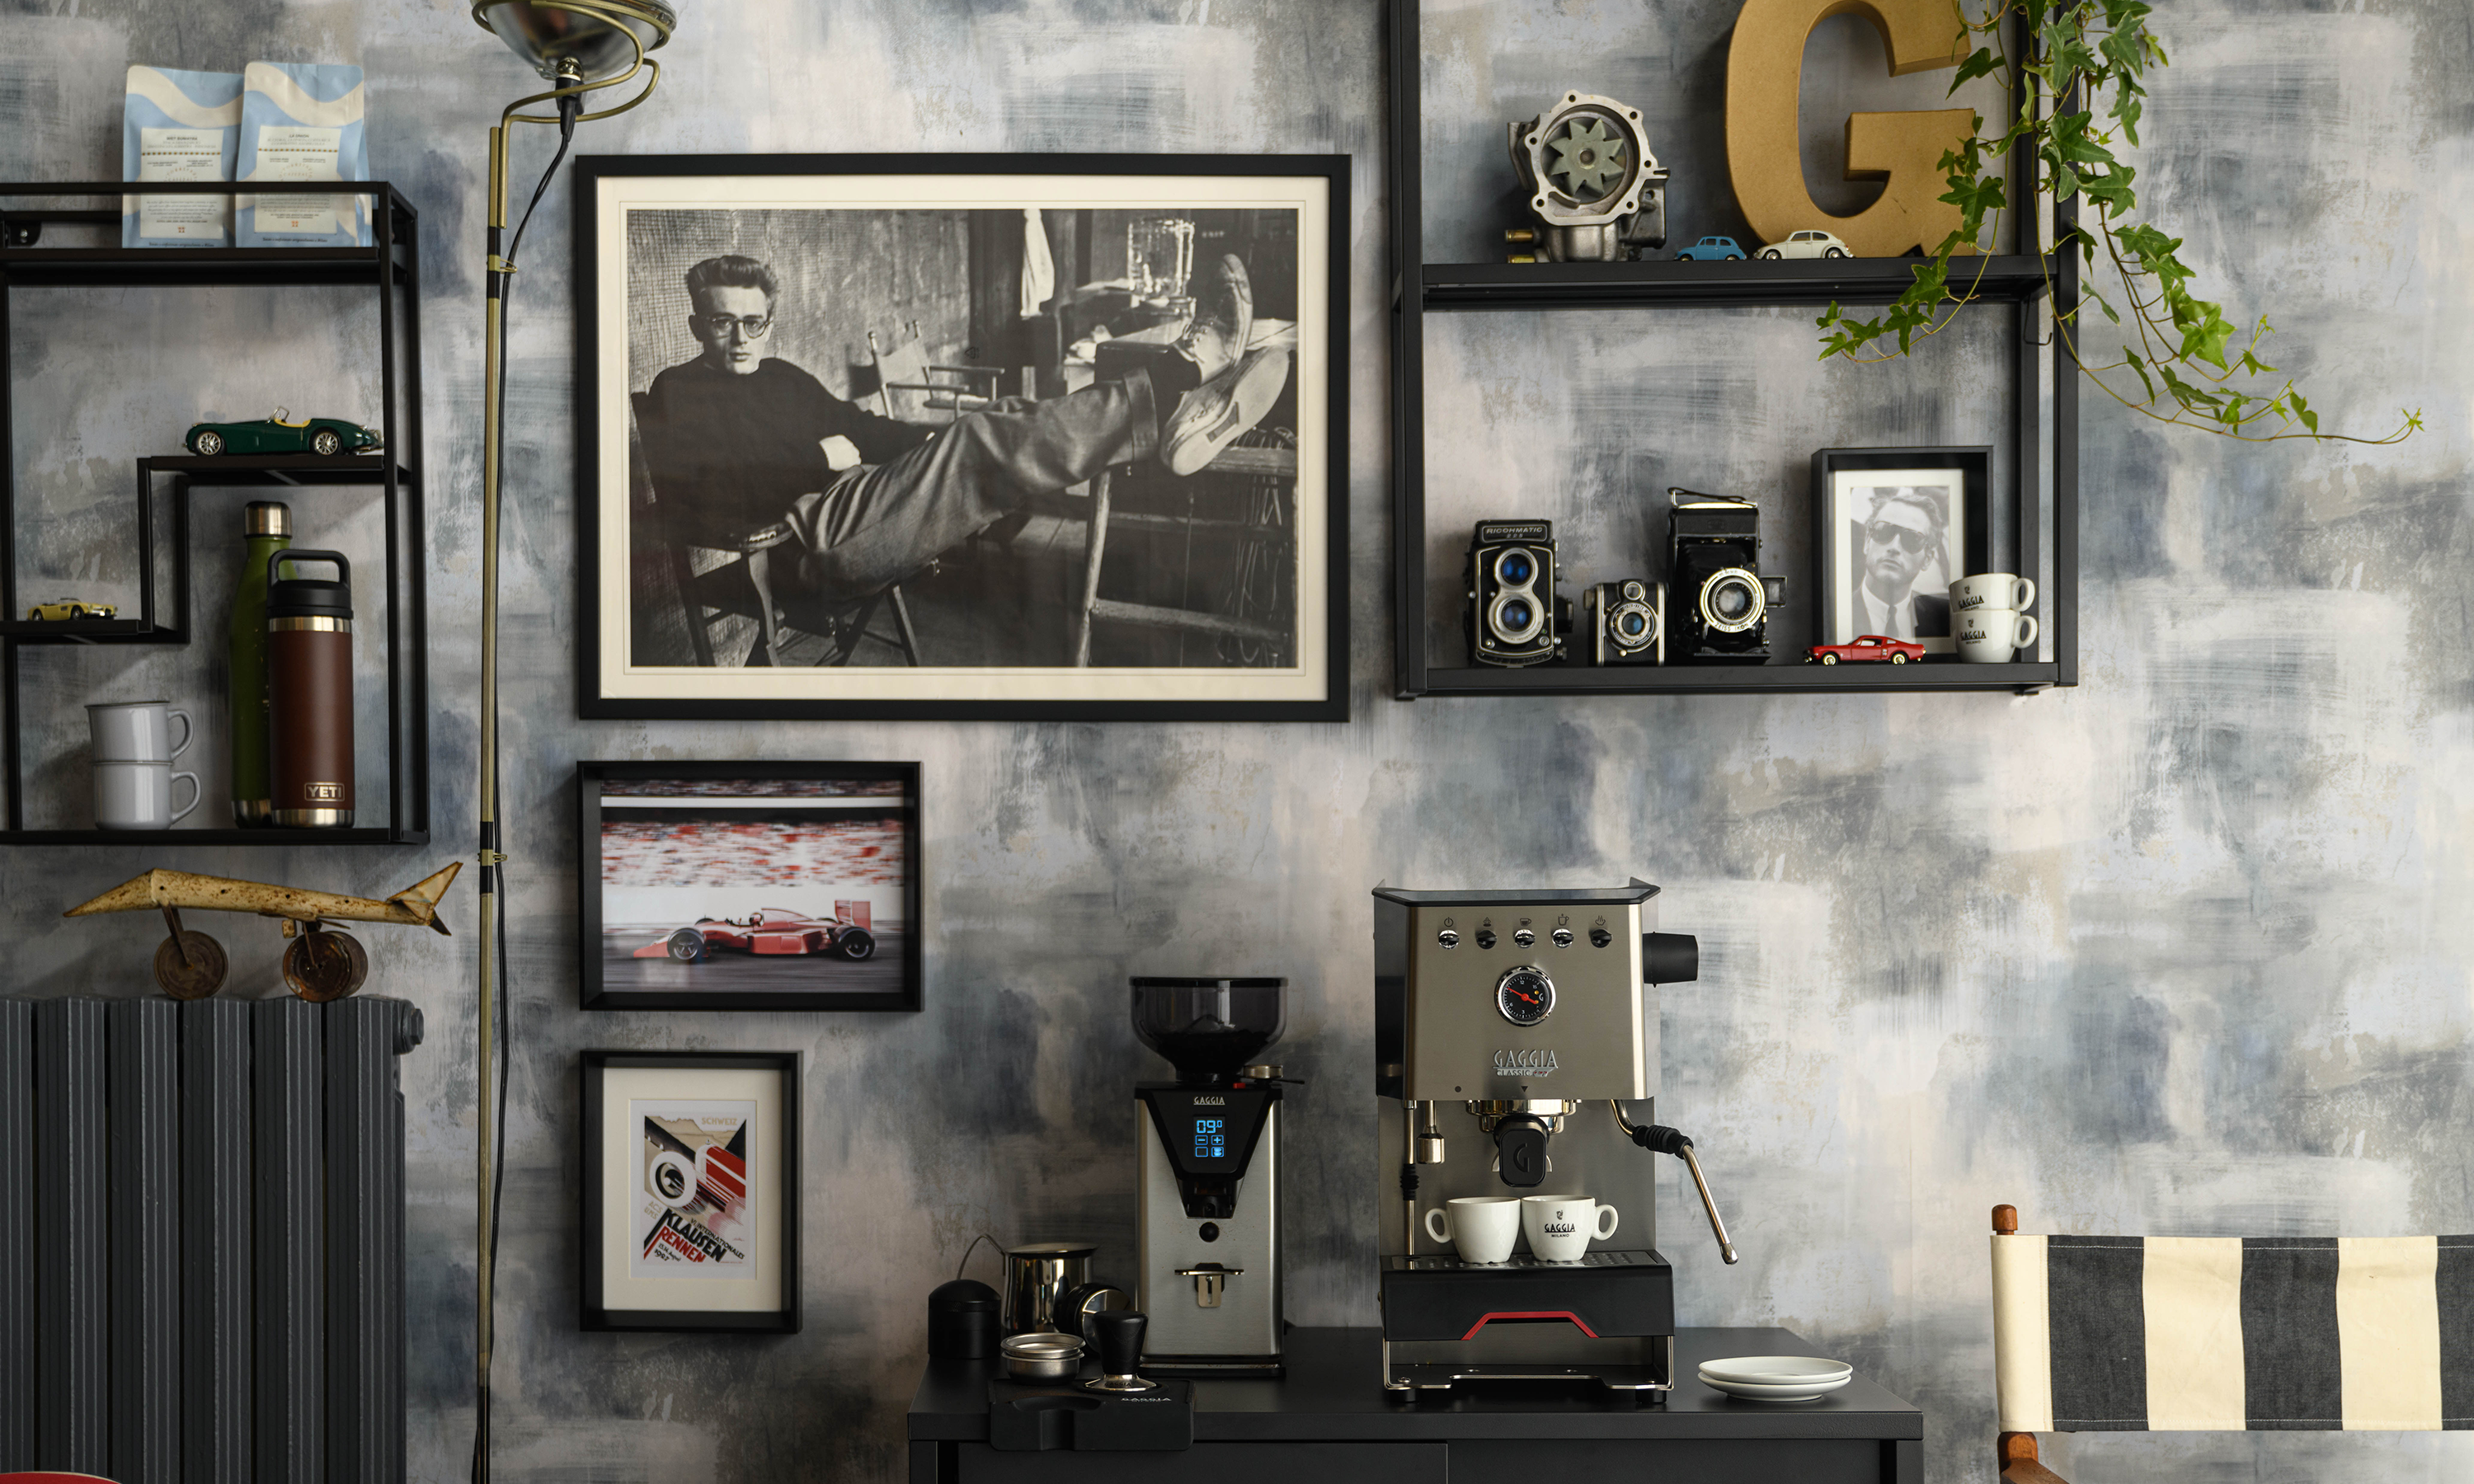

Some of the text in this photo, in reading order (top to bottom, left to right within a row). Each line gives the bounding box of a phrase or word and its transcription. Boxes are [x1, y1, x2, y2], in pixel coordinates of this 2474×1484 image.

[1959, 595, 1984, 609] GAGGIA
[1715, 622, 1748, 632] ZEISS IKON
[1960, 631, 1987, 641] GAGGIA
[308, 786, 342, 797] YETI
[1493, 1050, 1559, 1068] GAGGIA
[1193, 1097, 1225, 1106] GAGGIA
[701, 1117, 737, 1125] SCHWEIZ
[1545, 1223, 1576, 1233] GAGGIA
[644, 1208, 727, 1263] KLAUSEN
[697, 1222, 745, 1260] INTERNATIONALES
[644, 1225, 707, 1262] RENNEN
